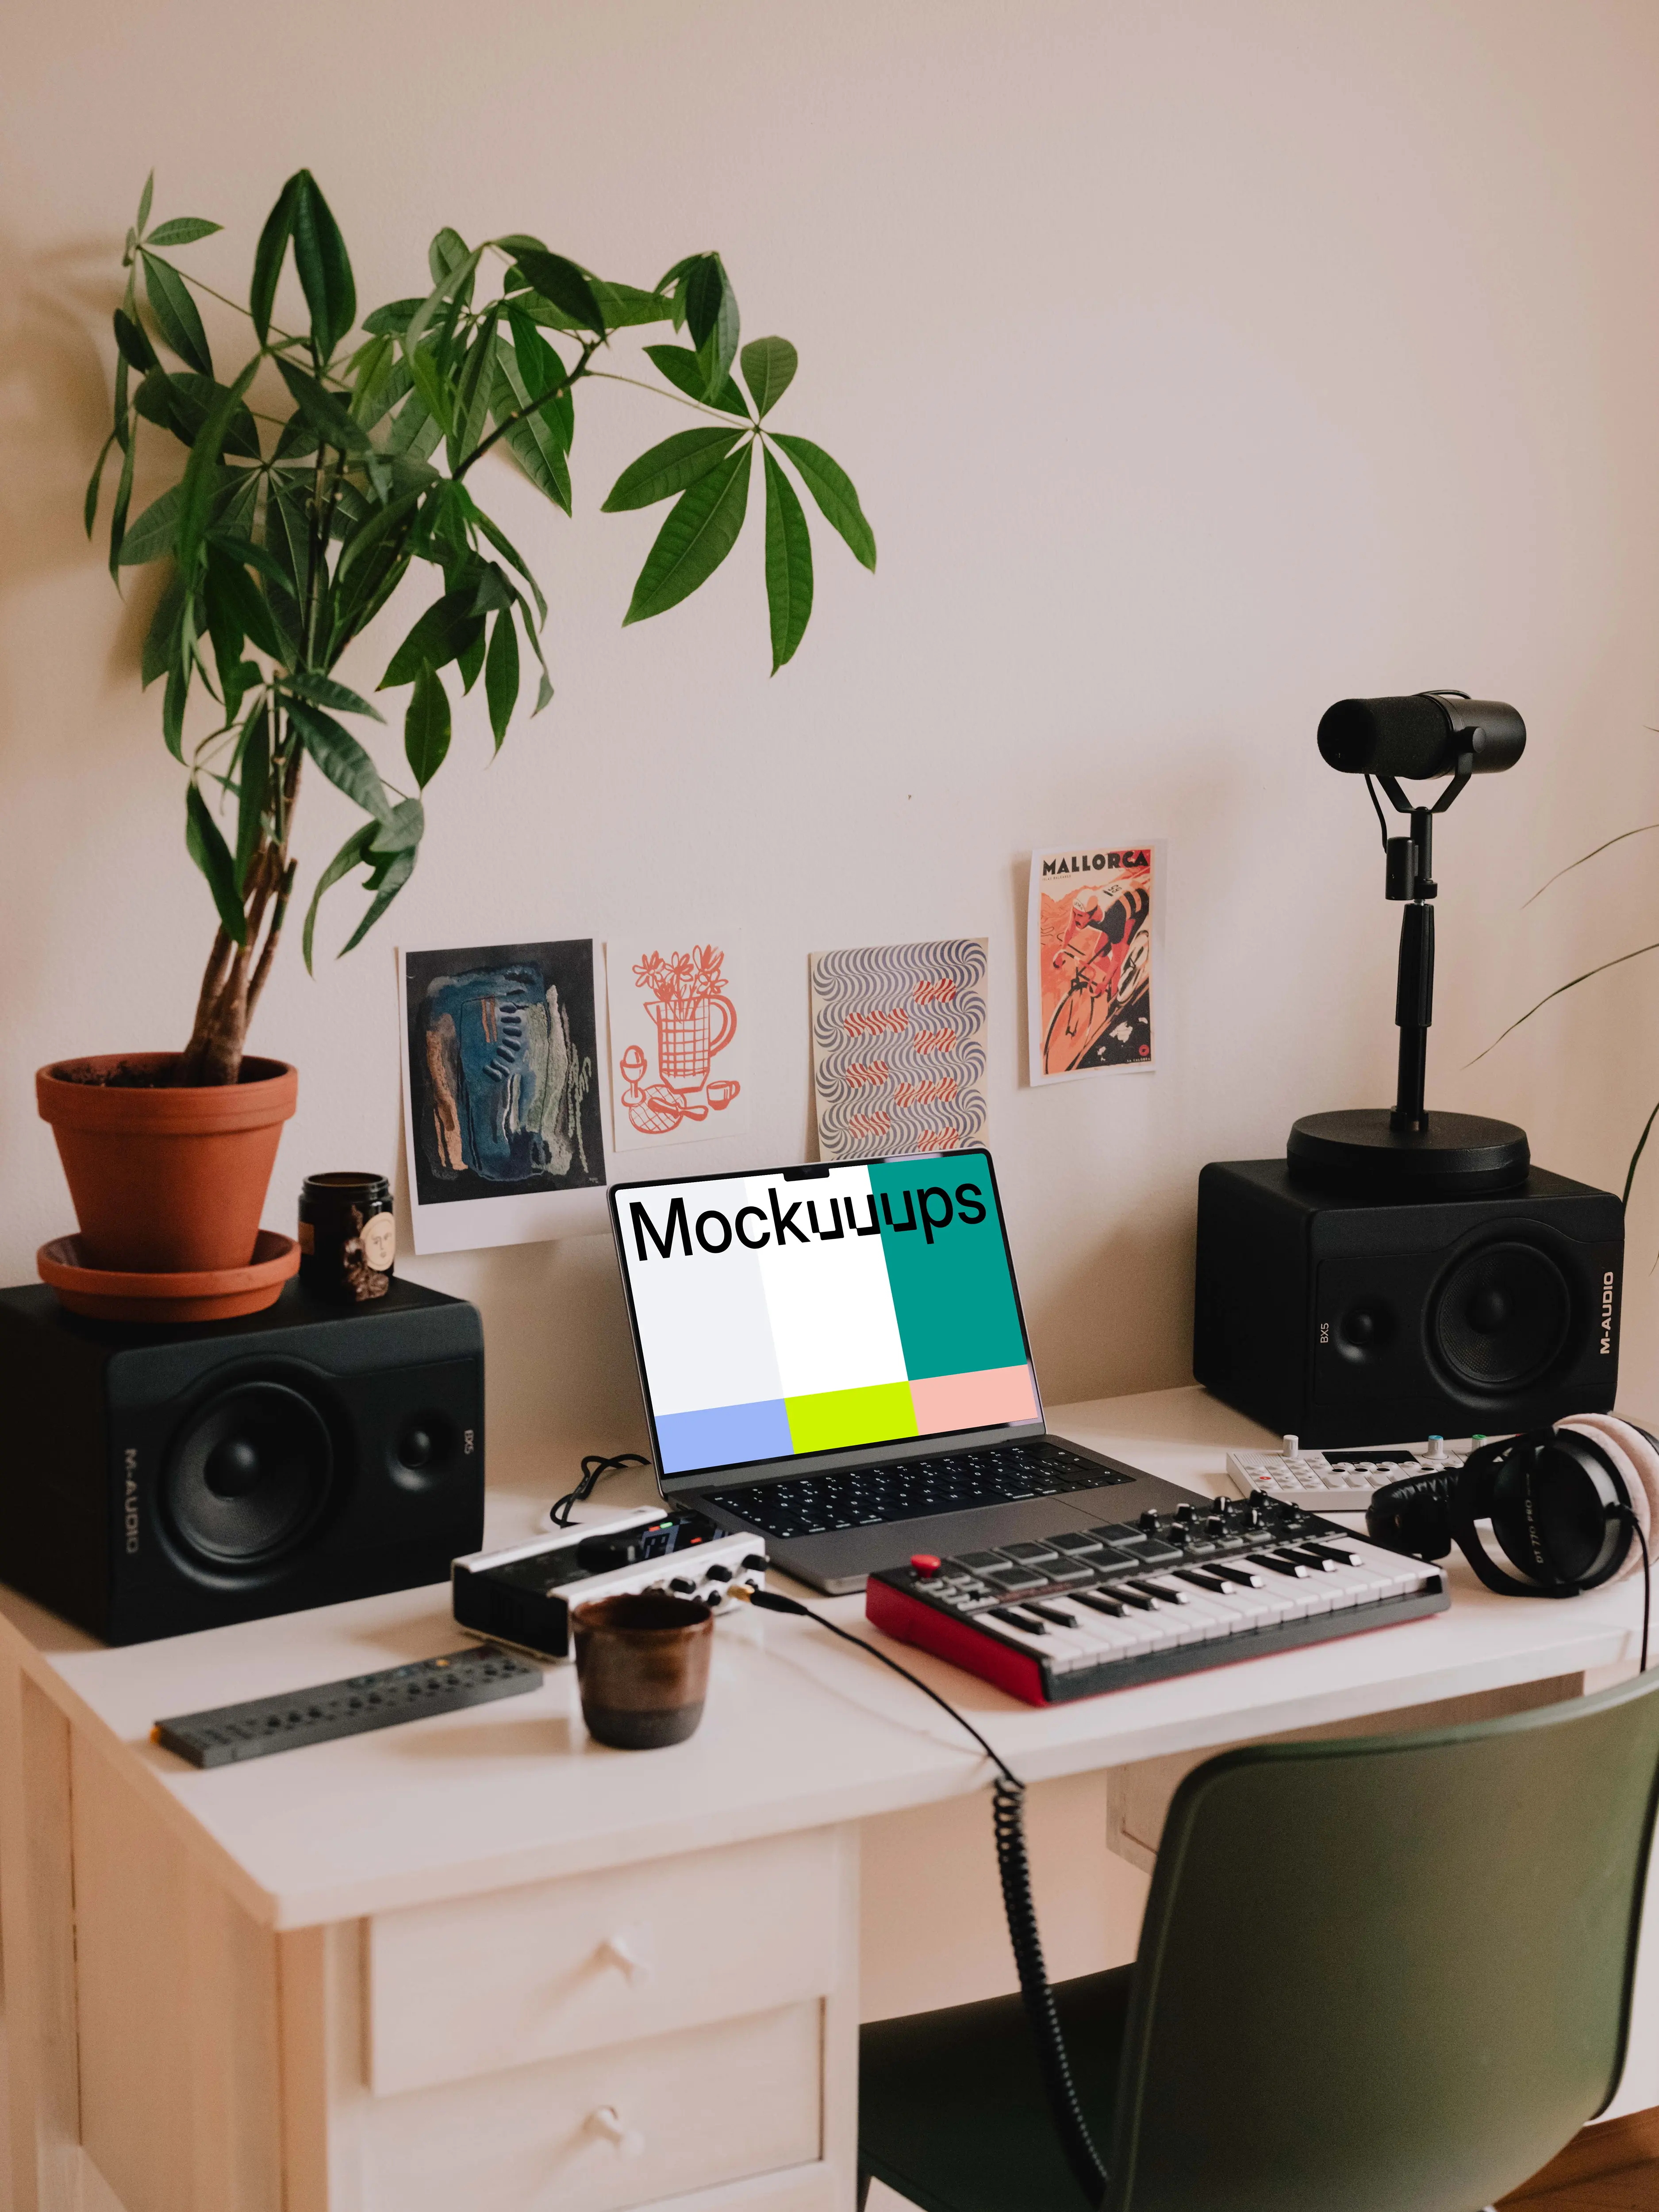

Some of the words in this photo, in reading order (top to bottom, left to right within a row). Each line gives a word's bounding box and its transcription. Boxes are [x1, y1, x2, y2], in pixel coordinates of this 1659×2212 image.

[1043, 851, 1149, 876] MALLORCA
[629, 1183, 987, 1261] Mockuuups
[1600, 1271, 1613, 1354] M-AUDIO
[1320, 1323, 1329, 1343] BX5
[124, 1448, 139, 1553] M-AUDIO
[1525, 1499, 1534, 1522] PRO
[1529, 1526, 1541, 1546] 770
